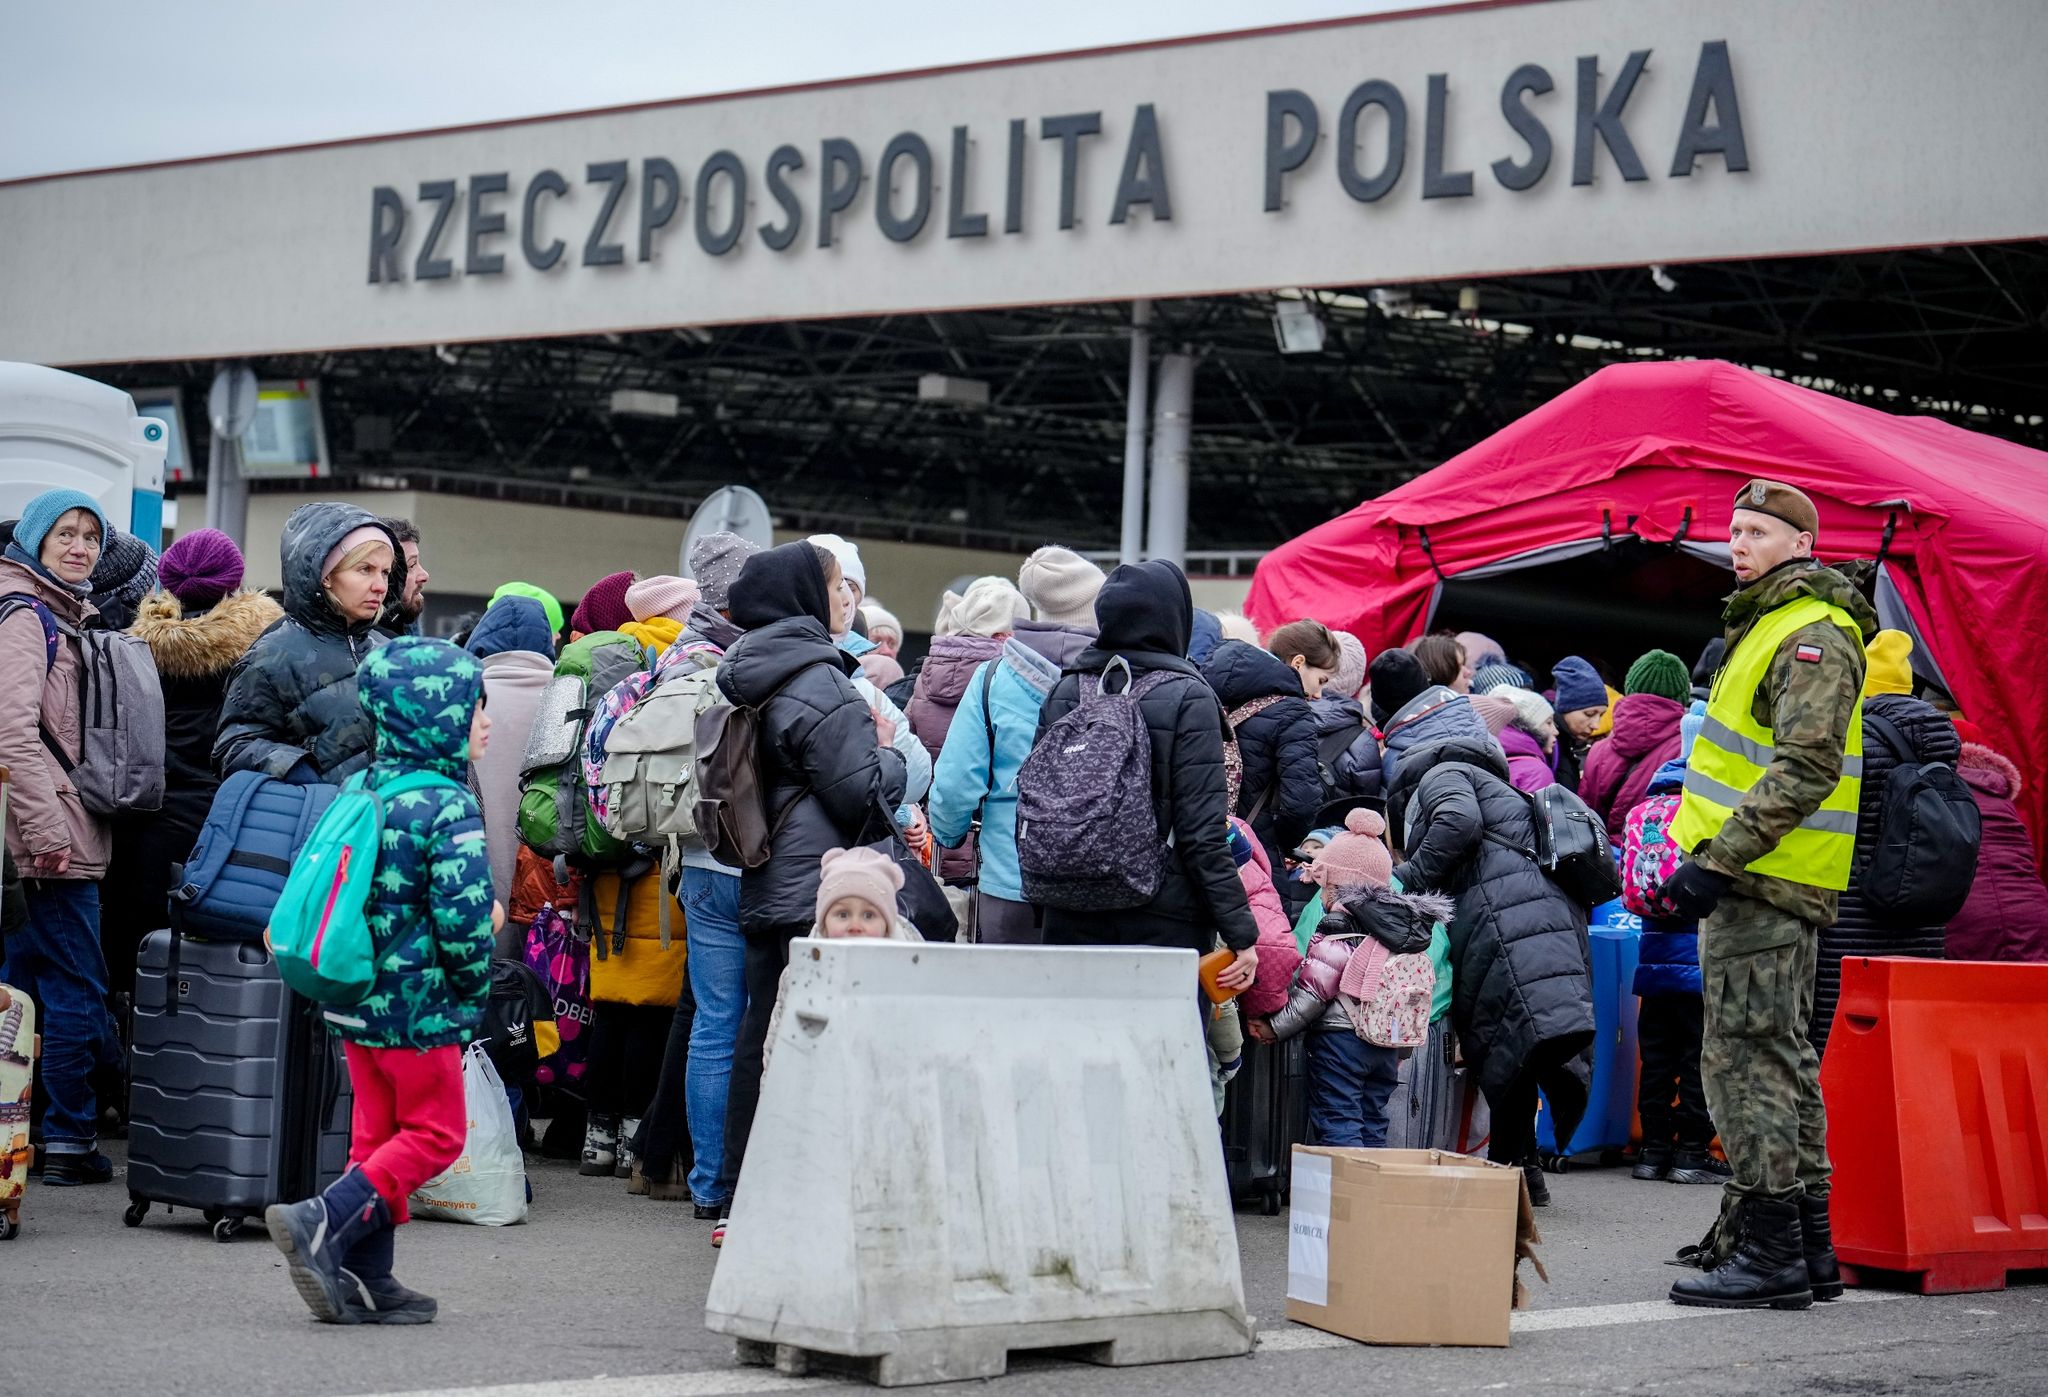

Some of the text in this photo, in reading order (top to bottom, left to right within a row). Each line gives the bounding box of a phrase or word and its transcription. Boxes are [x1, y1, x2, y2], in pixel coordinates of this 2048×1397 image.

[367, 39, 1750, 284] RZECZPOSPOLITA POLSKA
[510, 1034, 527, 1047] adidas
